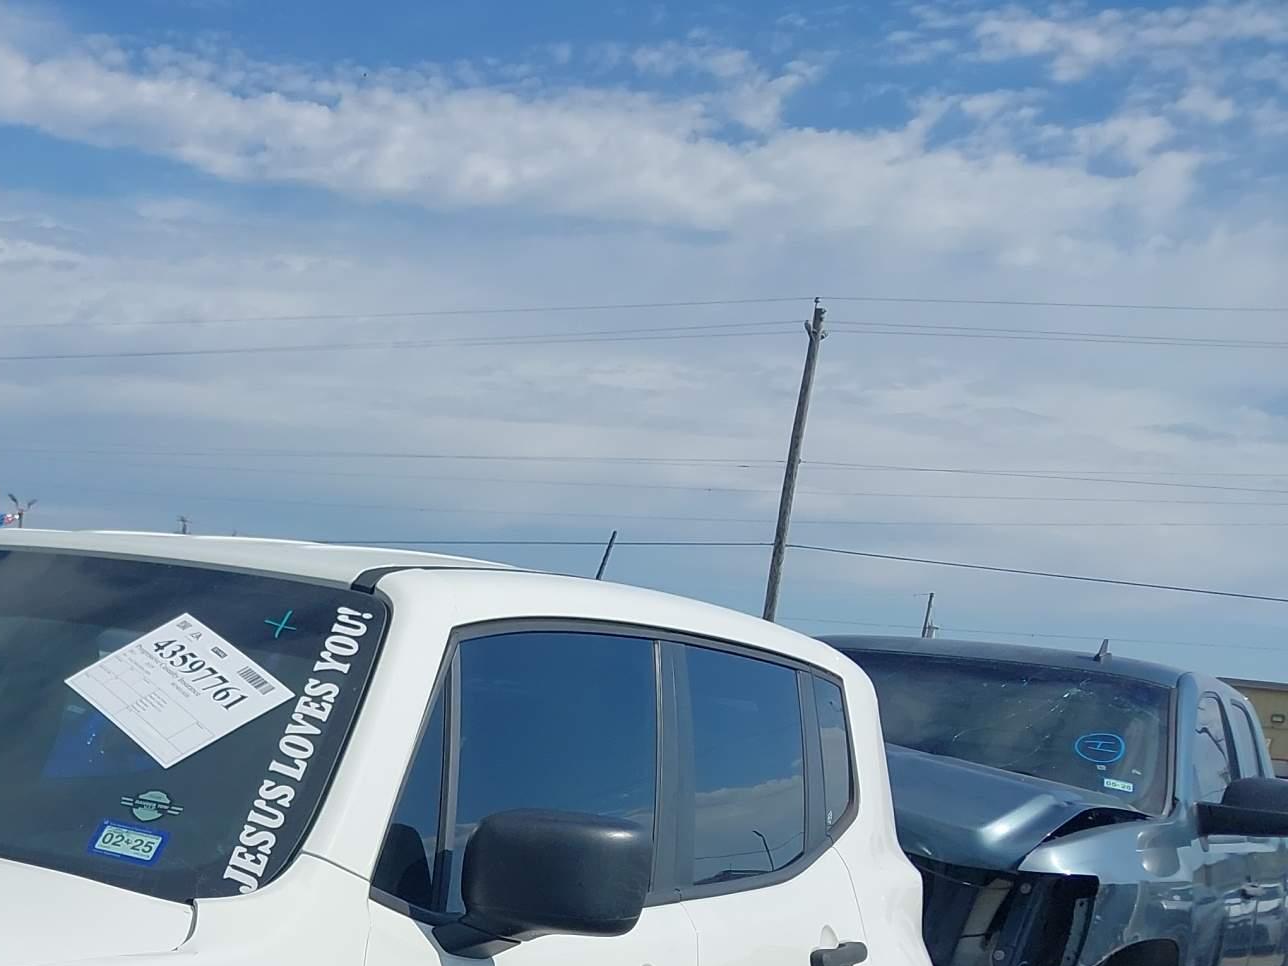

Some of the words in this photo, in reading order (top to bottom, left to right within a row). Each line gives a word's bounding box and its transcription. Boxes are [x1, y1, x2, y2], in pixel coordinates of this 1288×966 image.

[154, 640, 249, 710] 43597761
[223, 780, 295, 894] JESUS
[269, 678, 340, 781] LOVES
[314, 607, 373, 674] YOU!
